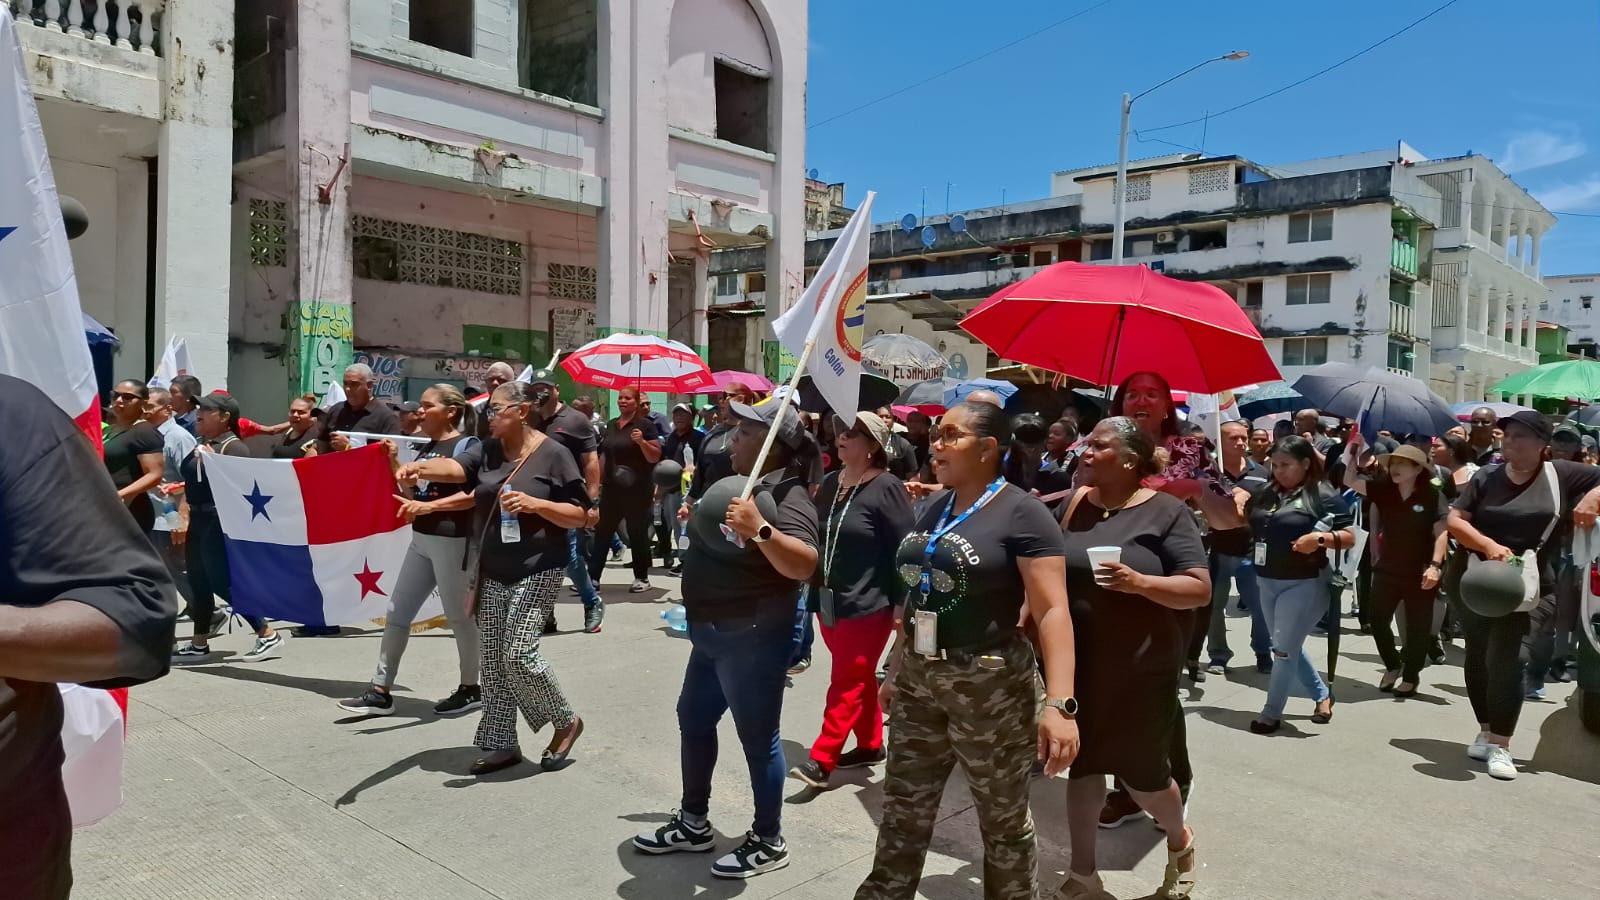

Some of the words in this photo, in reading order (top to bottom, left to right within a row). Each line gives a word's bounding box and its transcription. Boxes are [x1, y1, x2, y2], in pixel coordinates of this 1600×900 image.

[301, 303, 351, 325] CAR
[301, 319, 353, 344] WASH
[824, 347, 846, 377] Colón
[894, 365, 905, 379] EL
